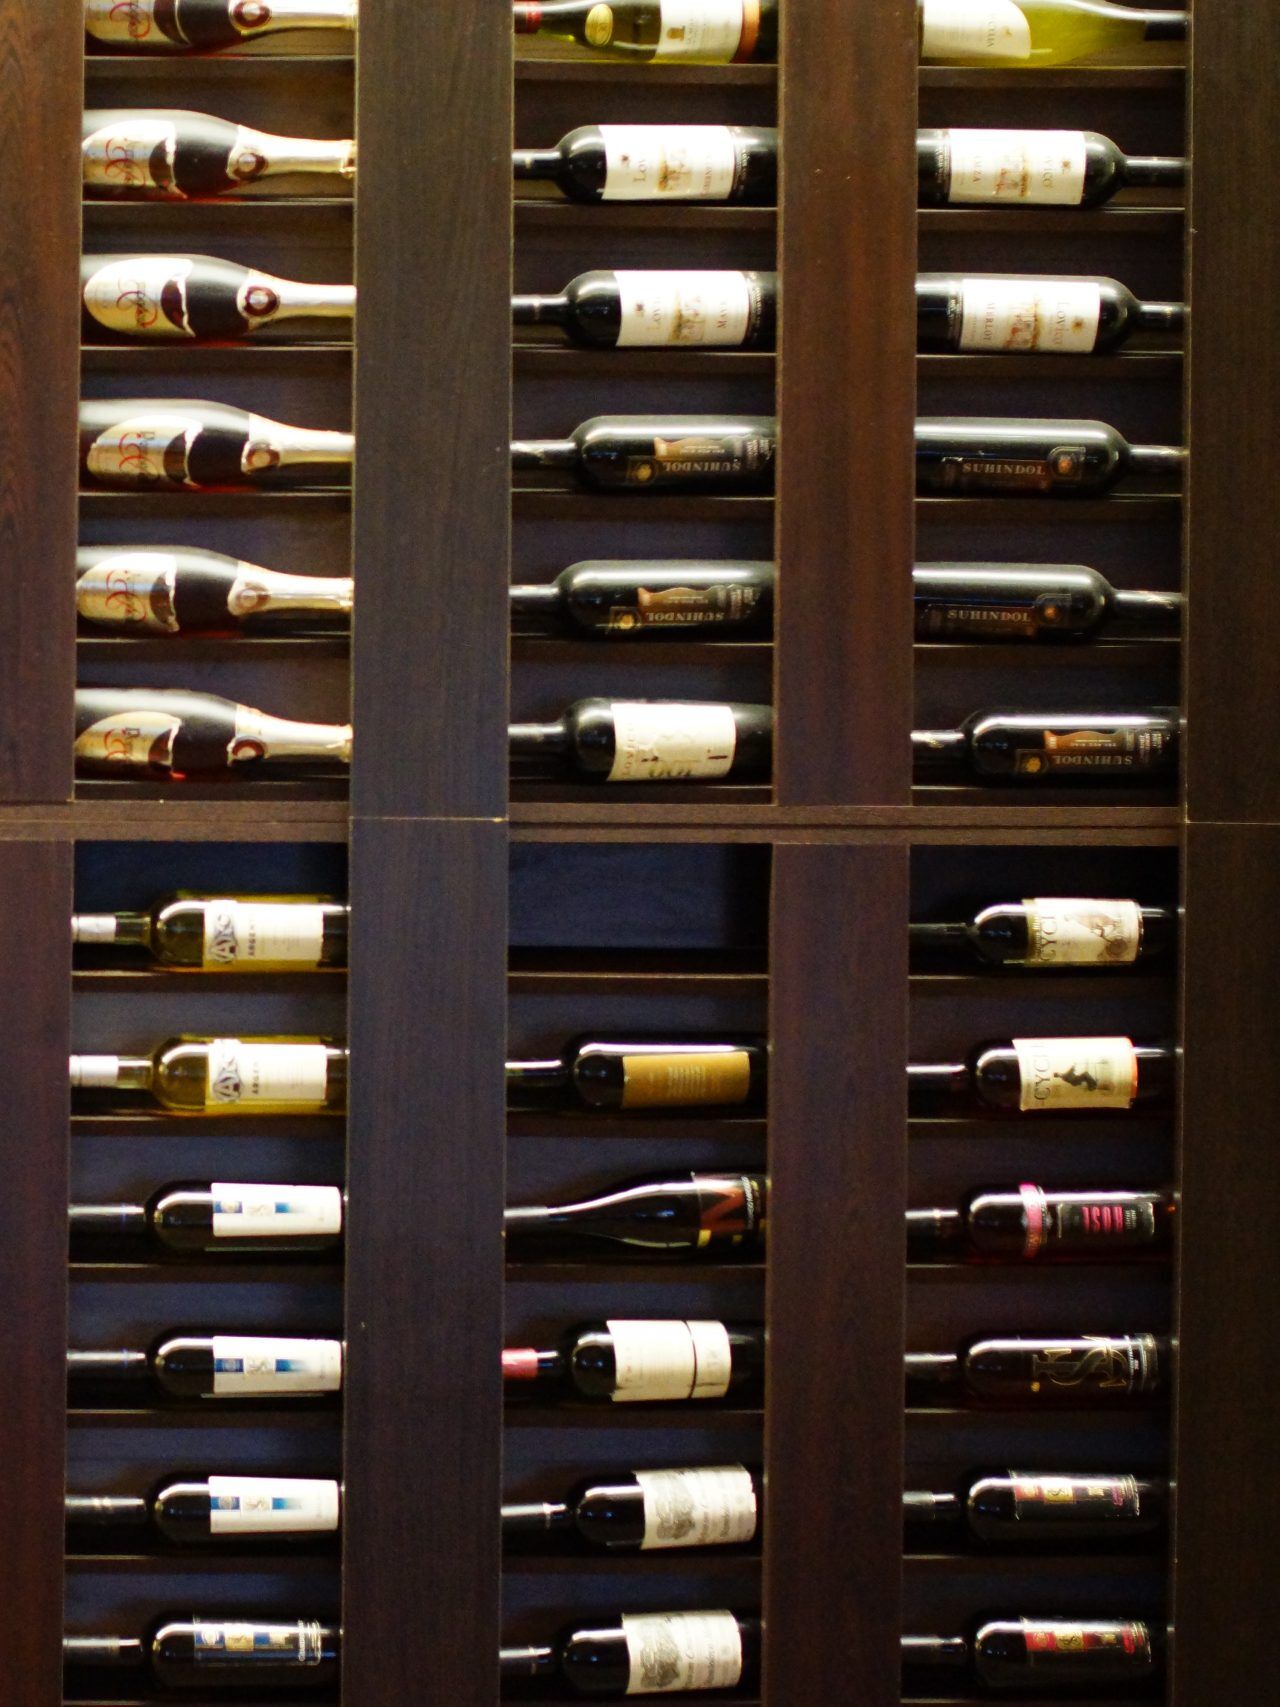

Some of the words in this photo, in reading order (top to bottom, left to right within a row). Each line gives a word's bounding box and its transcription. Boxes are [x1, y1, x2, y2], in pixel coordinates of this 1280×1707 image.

[661, 461, 741, 472] SUHINDOL
[962, 462, 1046, 475] SUHINDOL
[645, 611, 725, 622] SUHINDOL
[947, 609, 1032, 622] SUHINDOL
[1051, 755, 1133, 765] SUHINDOL
